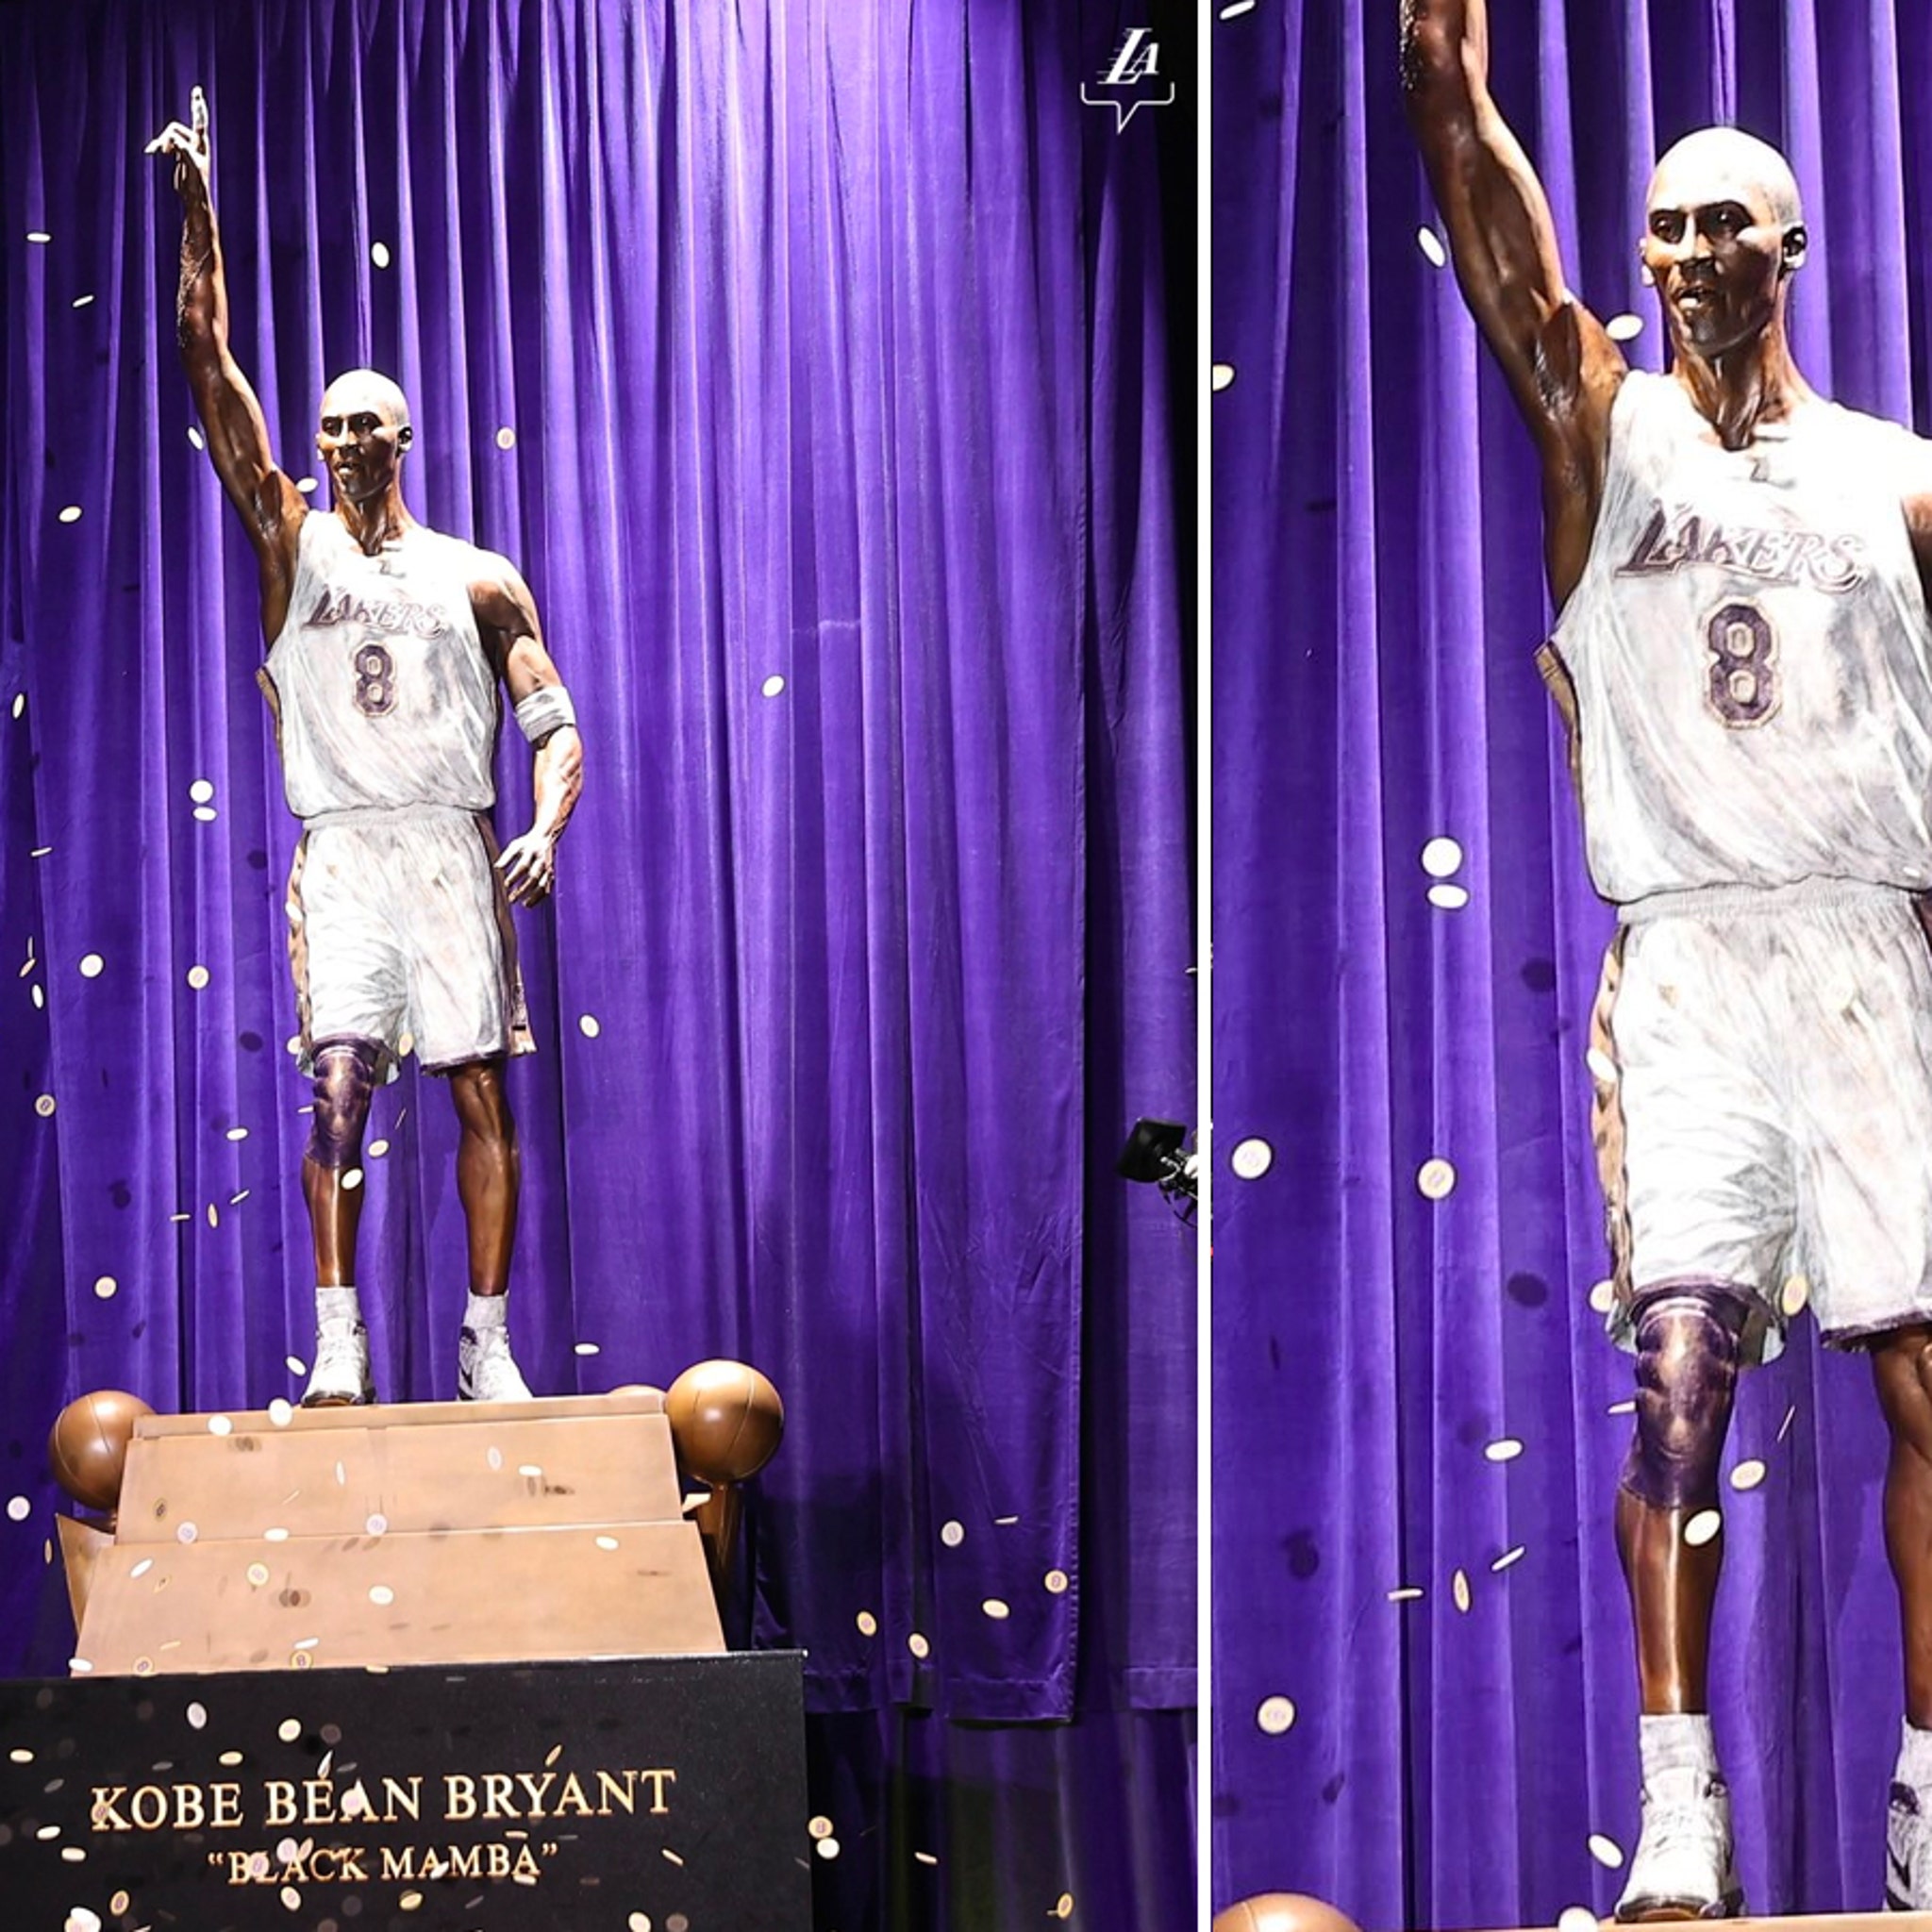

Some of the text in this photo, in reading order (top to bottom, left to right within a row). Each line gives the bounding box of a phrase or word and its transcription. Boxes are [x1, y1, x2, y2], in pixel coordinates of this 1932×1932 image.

[1614, 498, 1869, 594] LAKERS
[300, 583, 449, 640] LAKERS
[352, 641, 396, 717] 8
[1706, 597, 1781, 727] 8
[92, 1769, 676, 1831] KOBE BEAN BRYANT
